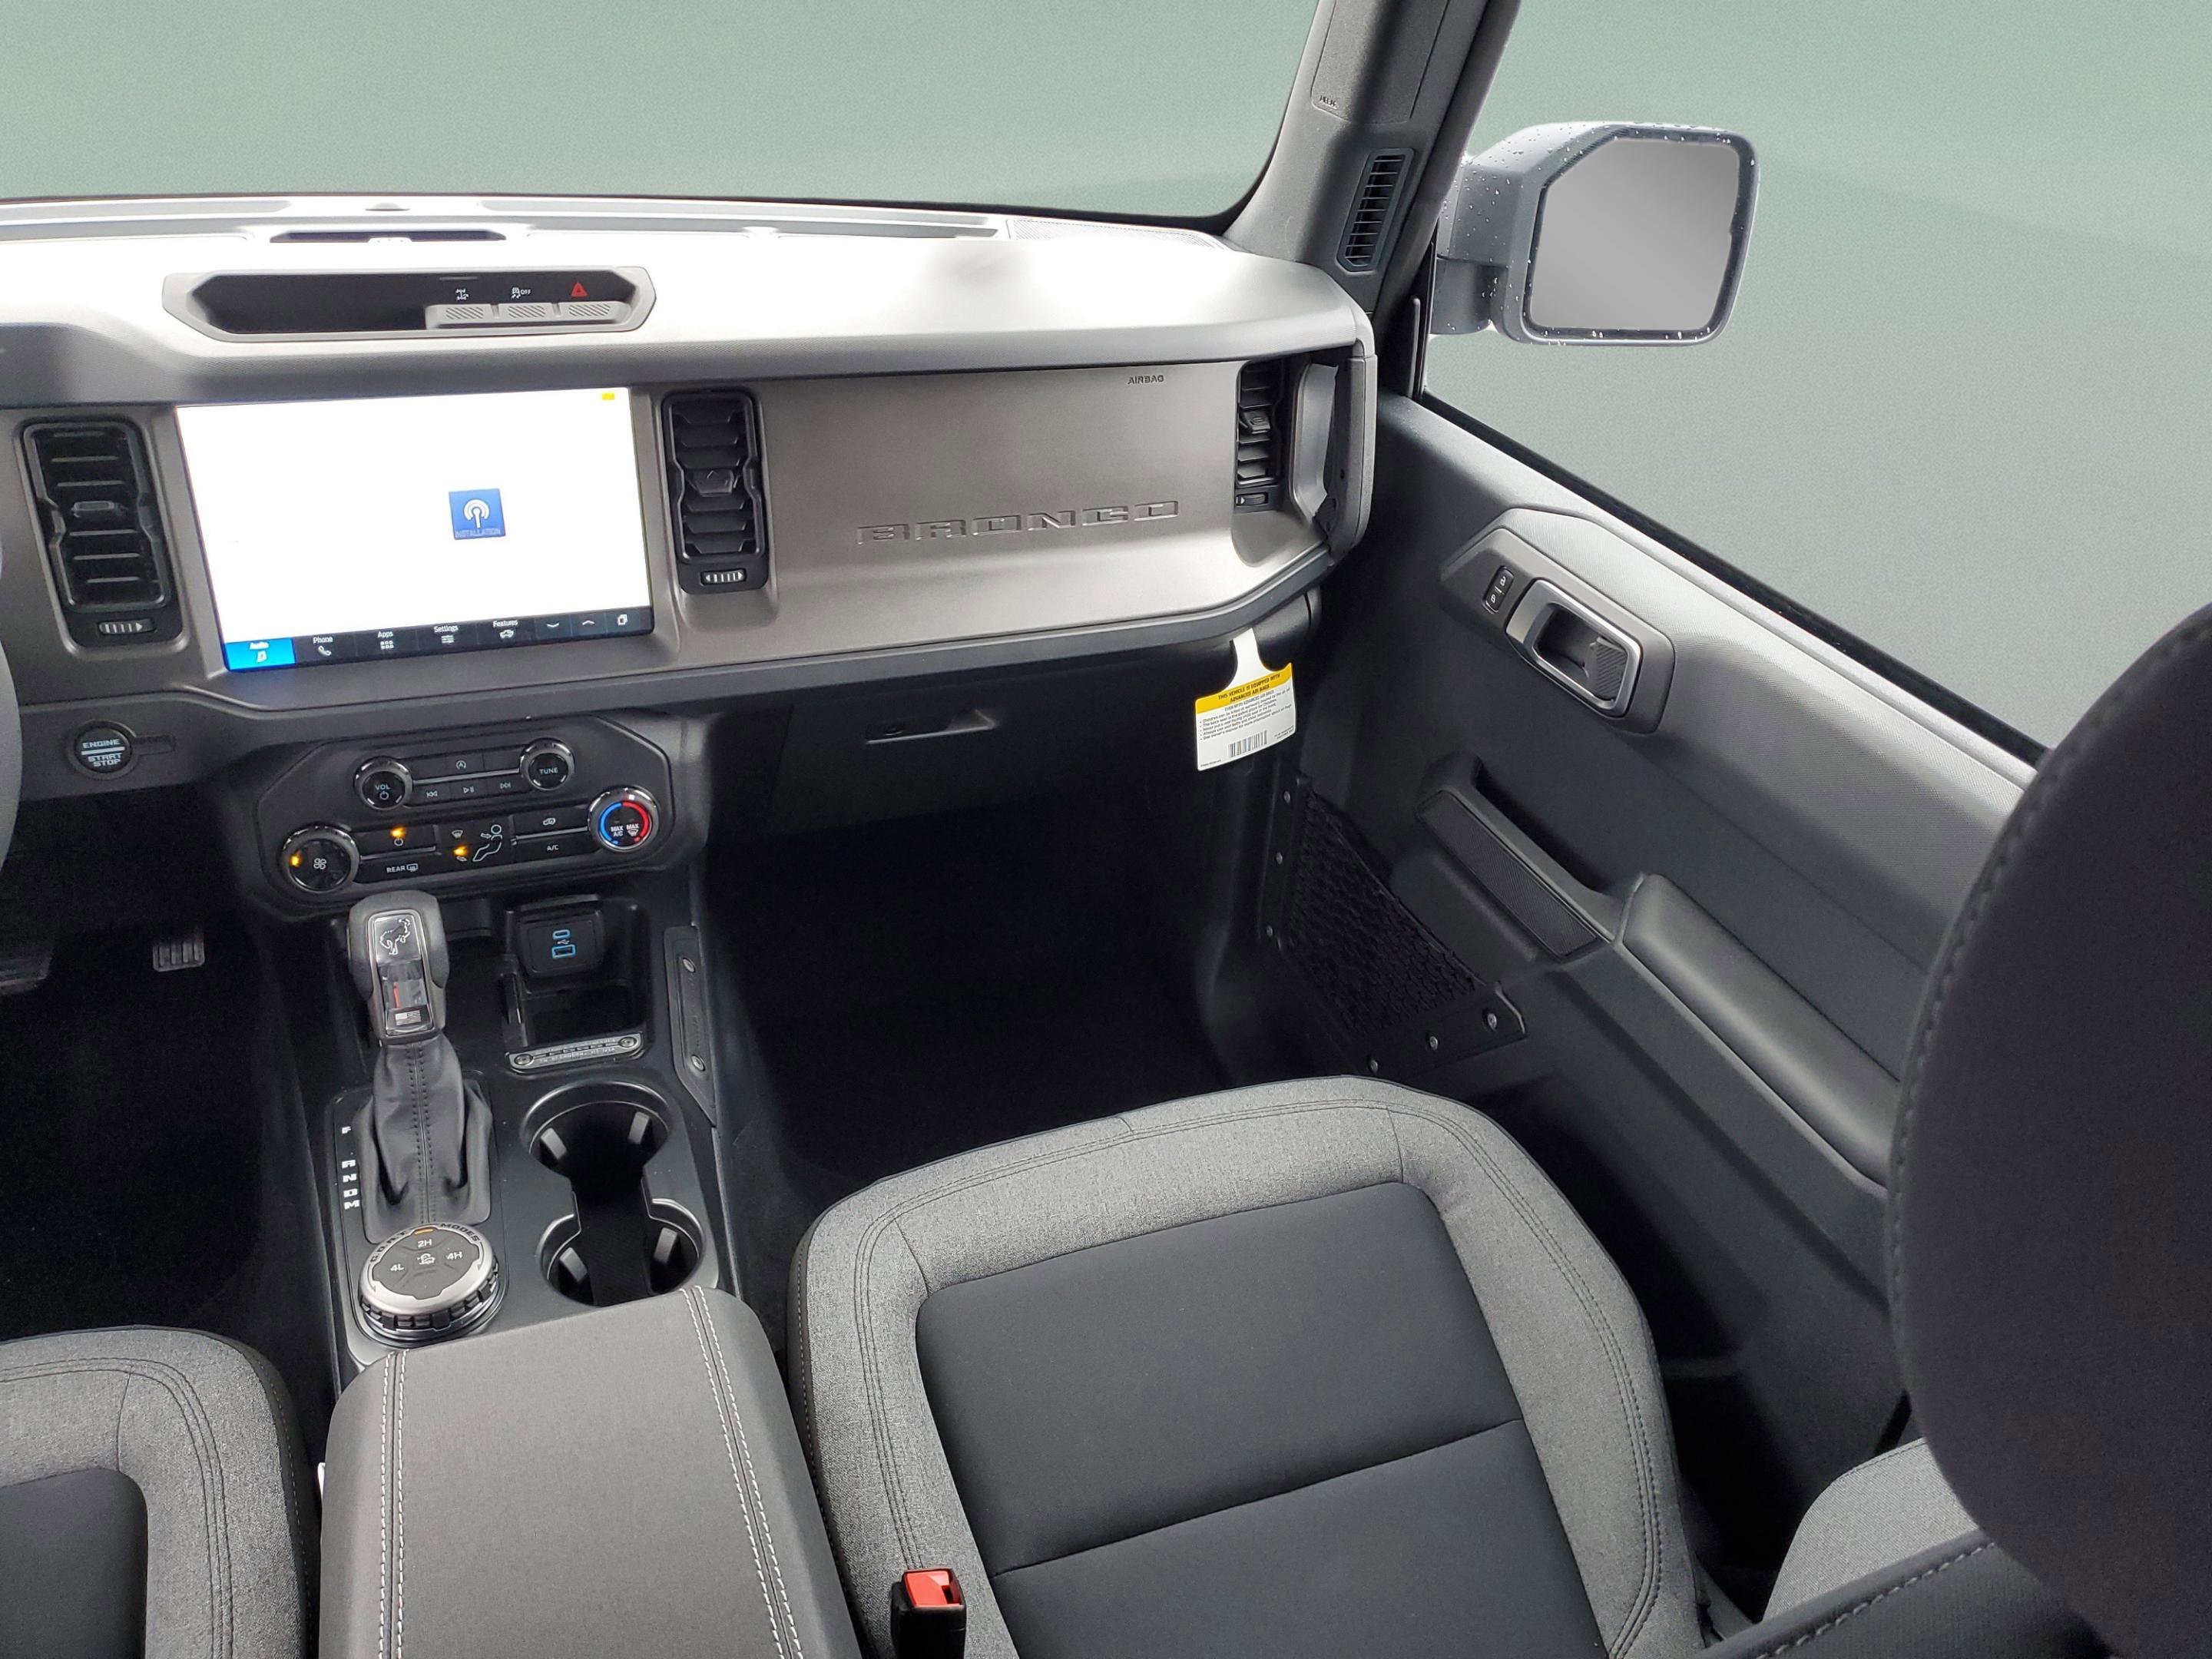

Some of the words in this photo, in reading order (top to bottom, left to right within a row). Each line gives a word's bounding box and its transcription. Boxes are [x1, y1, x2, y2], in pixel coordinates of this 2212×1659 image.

[1128, 375, 1164, 384] AIRBAG
[857, 501, 1179, 544] BRONCO
[492, 620, 518, 628] Features
[434, 624, 459, 634] Settings
[377, 631, 394, 639] Apps
[313, 636, 333, 644] Phone
[249, 642, 269, 651] Audio
[1229, 687, 1244, 697] VEHICLE
[1250, 677, 1269, 688] EQUIPPED
[1230, 691, 1250, 703] ADVANCED
[82, 739, 121, 748] ENGINE
[88, 753, 122, 762] START
[386, 865, 405, 873] REAR
[343, 1173, 357, 1182] N
[344, 1199, 359, 1210] M
[440, 1223, 480, 1243] MODES
[417, 1238, 432, 1248] 2H
[445, 1251, 462, 1260] 4H
[390, 1263, 404, 1272] 4L
